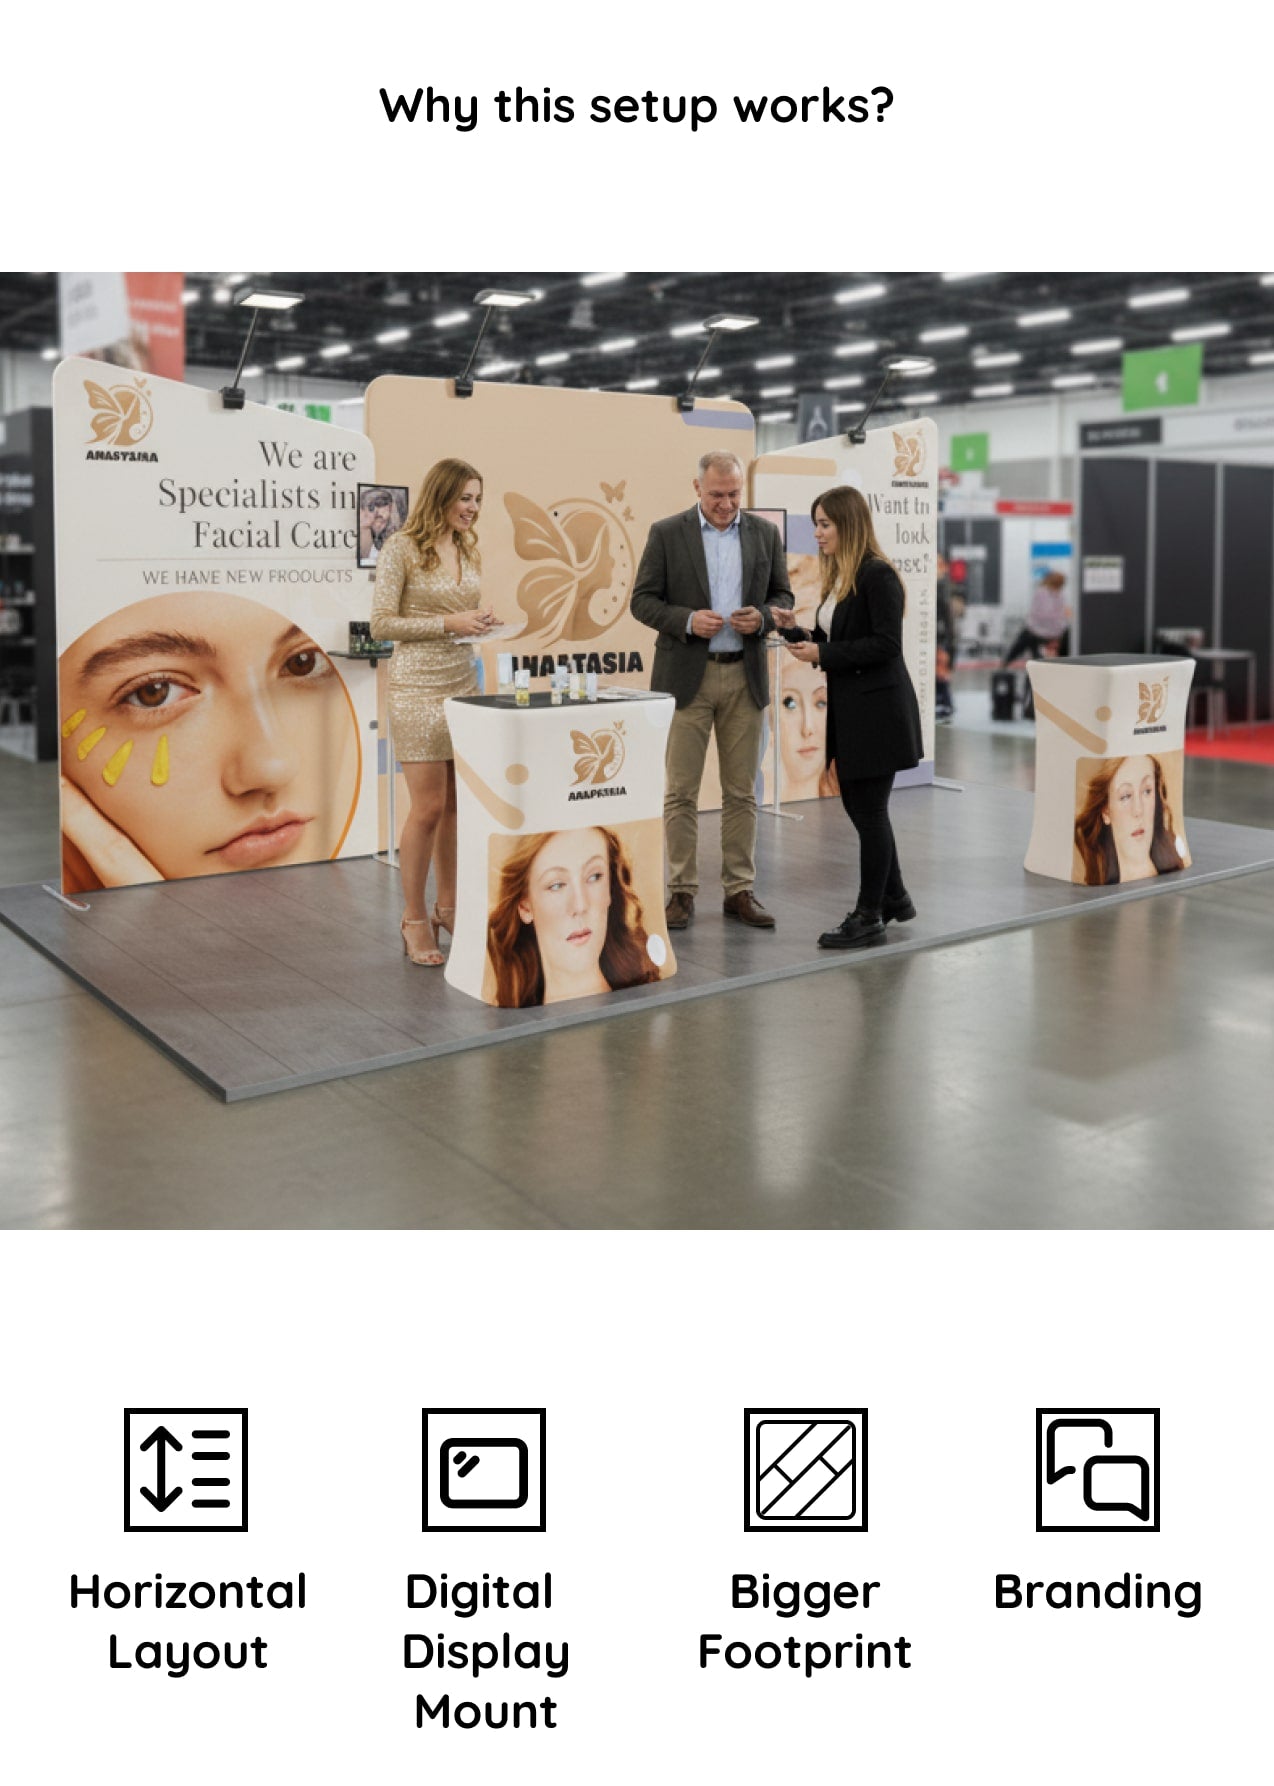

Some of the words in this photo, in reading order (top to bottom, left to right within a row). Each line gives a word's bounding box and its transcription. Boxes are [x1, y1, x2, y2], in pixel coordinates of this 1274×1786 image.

[259, 441, 303, 469] We
[313, 451, 356, 472] are
[159, 478, 320, 514] Specialists
[331, 481, 356, 511] in
[193, 520, 280, 548] Facial
[290, 521, 357, 549] Care
[142, 570, 169, 585] WE
[226, 569, 263, 584] NEW
